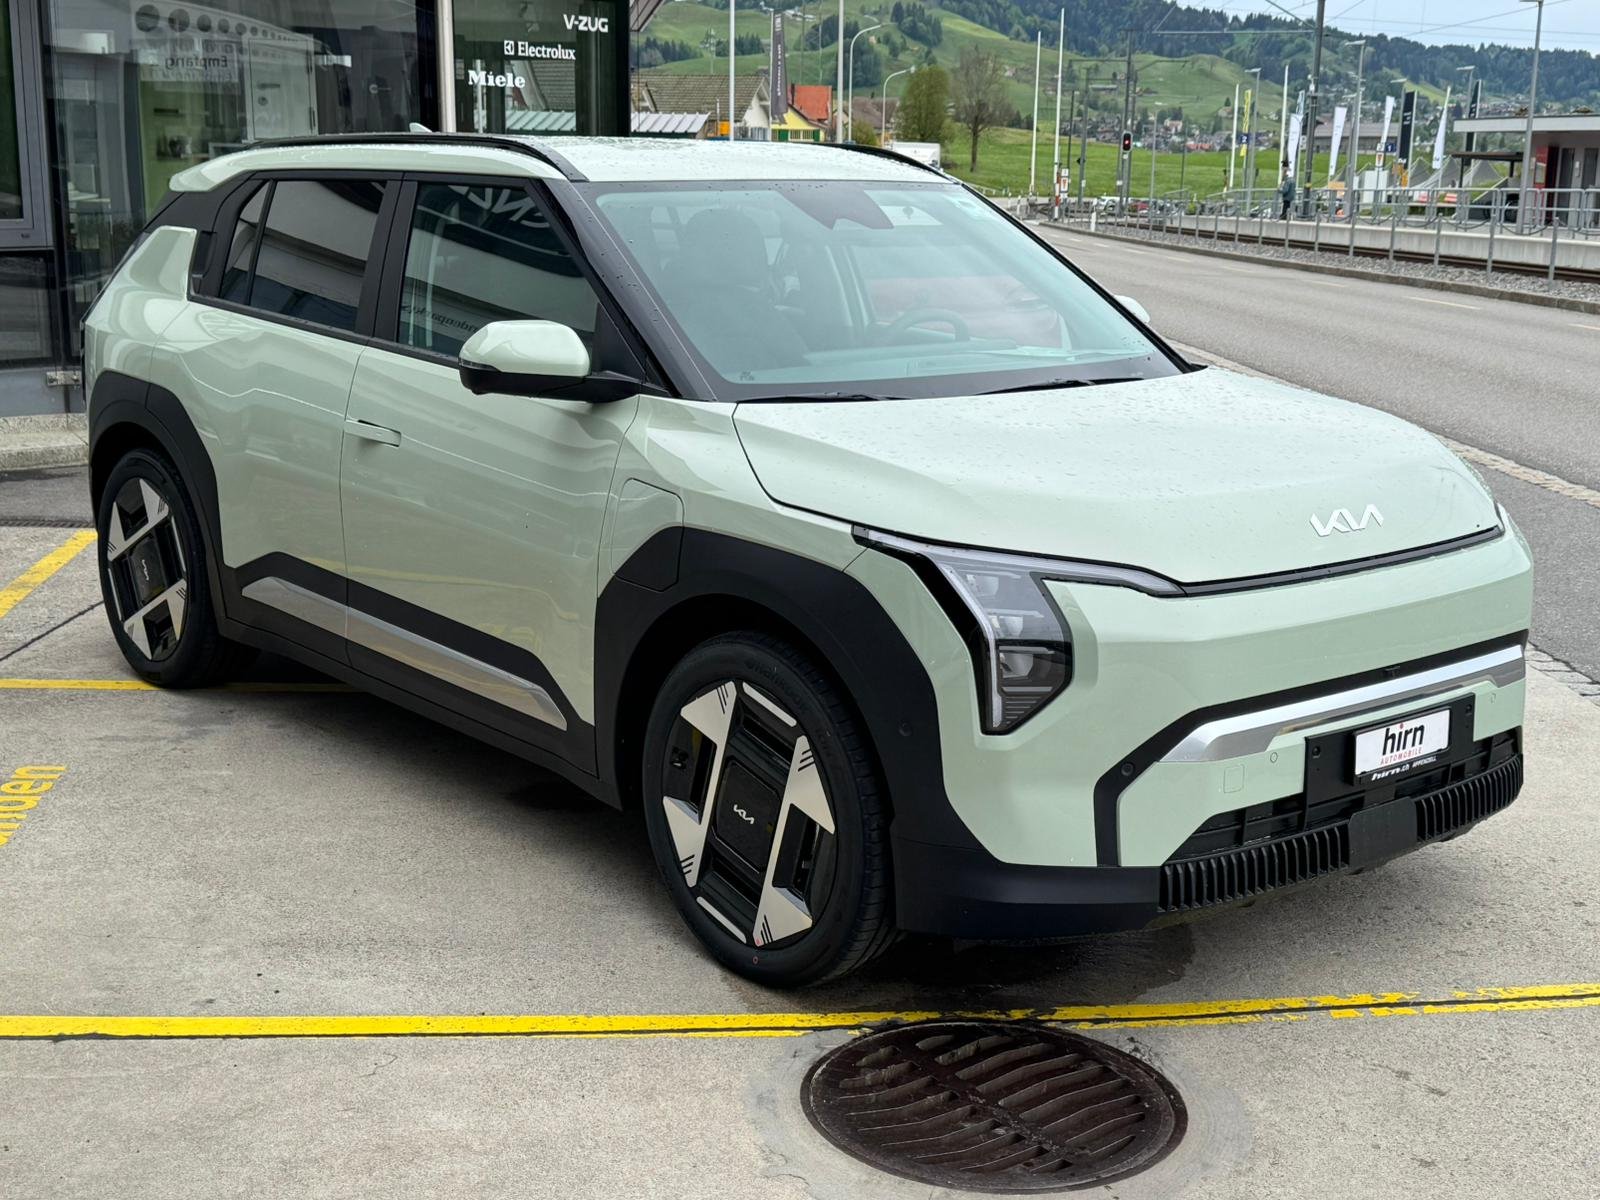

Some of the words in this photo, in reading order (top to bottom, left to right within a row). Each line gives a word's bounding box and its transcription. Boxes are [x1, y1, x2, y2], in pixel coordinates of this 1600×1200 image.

[563, 14, 609, 33] V-ZUG
[518, 41, 576, 60] Electrolux
[468, 70, 526, 88] Miele
[1382, 722, 1425, 755] hirn
[1380, 747, 1423, 765] AUTOMOBILE
